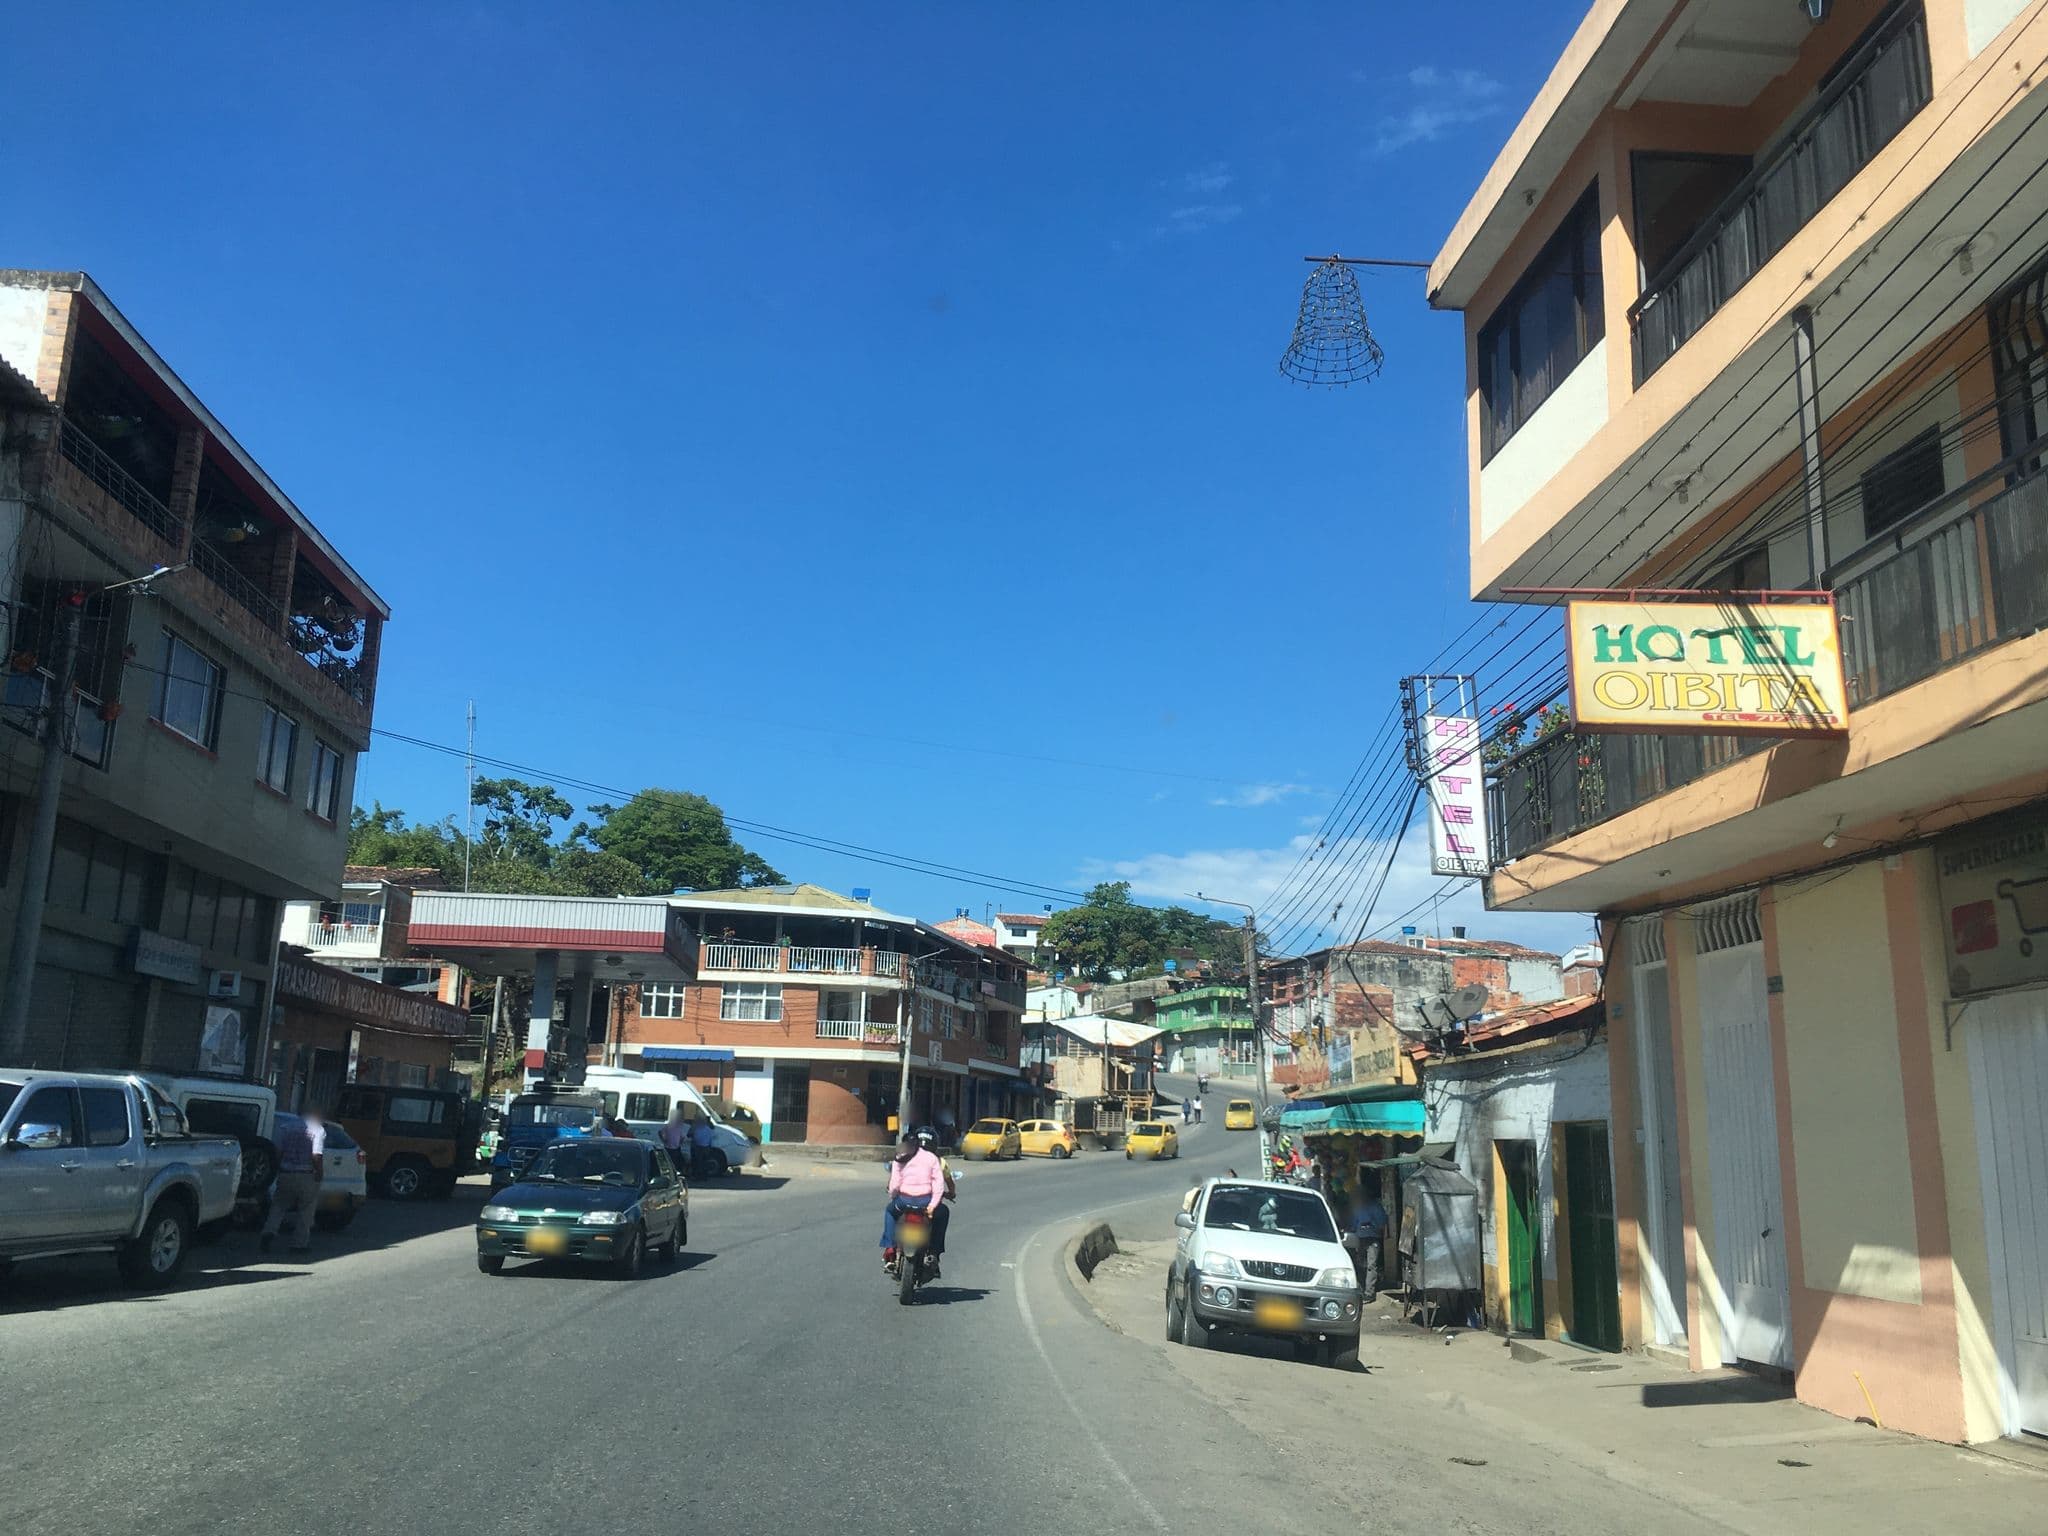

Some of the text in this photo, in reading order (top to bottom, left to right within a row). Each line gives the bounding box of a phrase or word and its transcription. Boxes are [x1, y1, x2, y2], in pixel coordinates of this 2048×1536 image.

[1592, 624, 1815, 666] HOTEL
[1593, 671, 1832, 713] OIBITA
[1435, 719, 1475, 853] HOTEL
